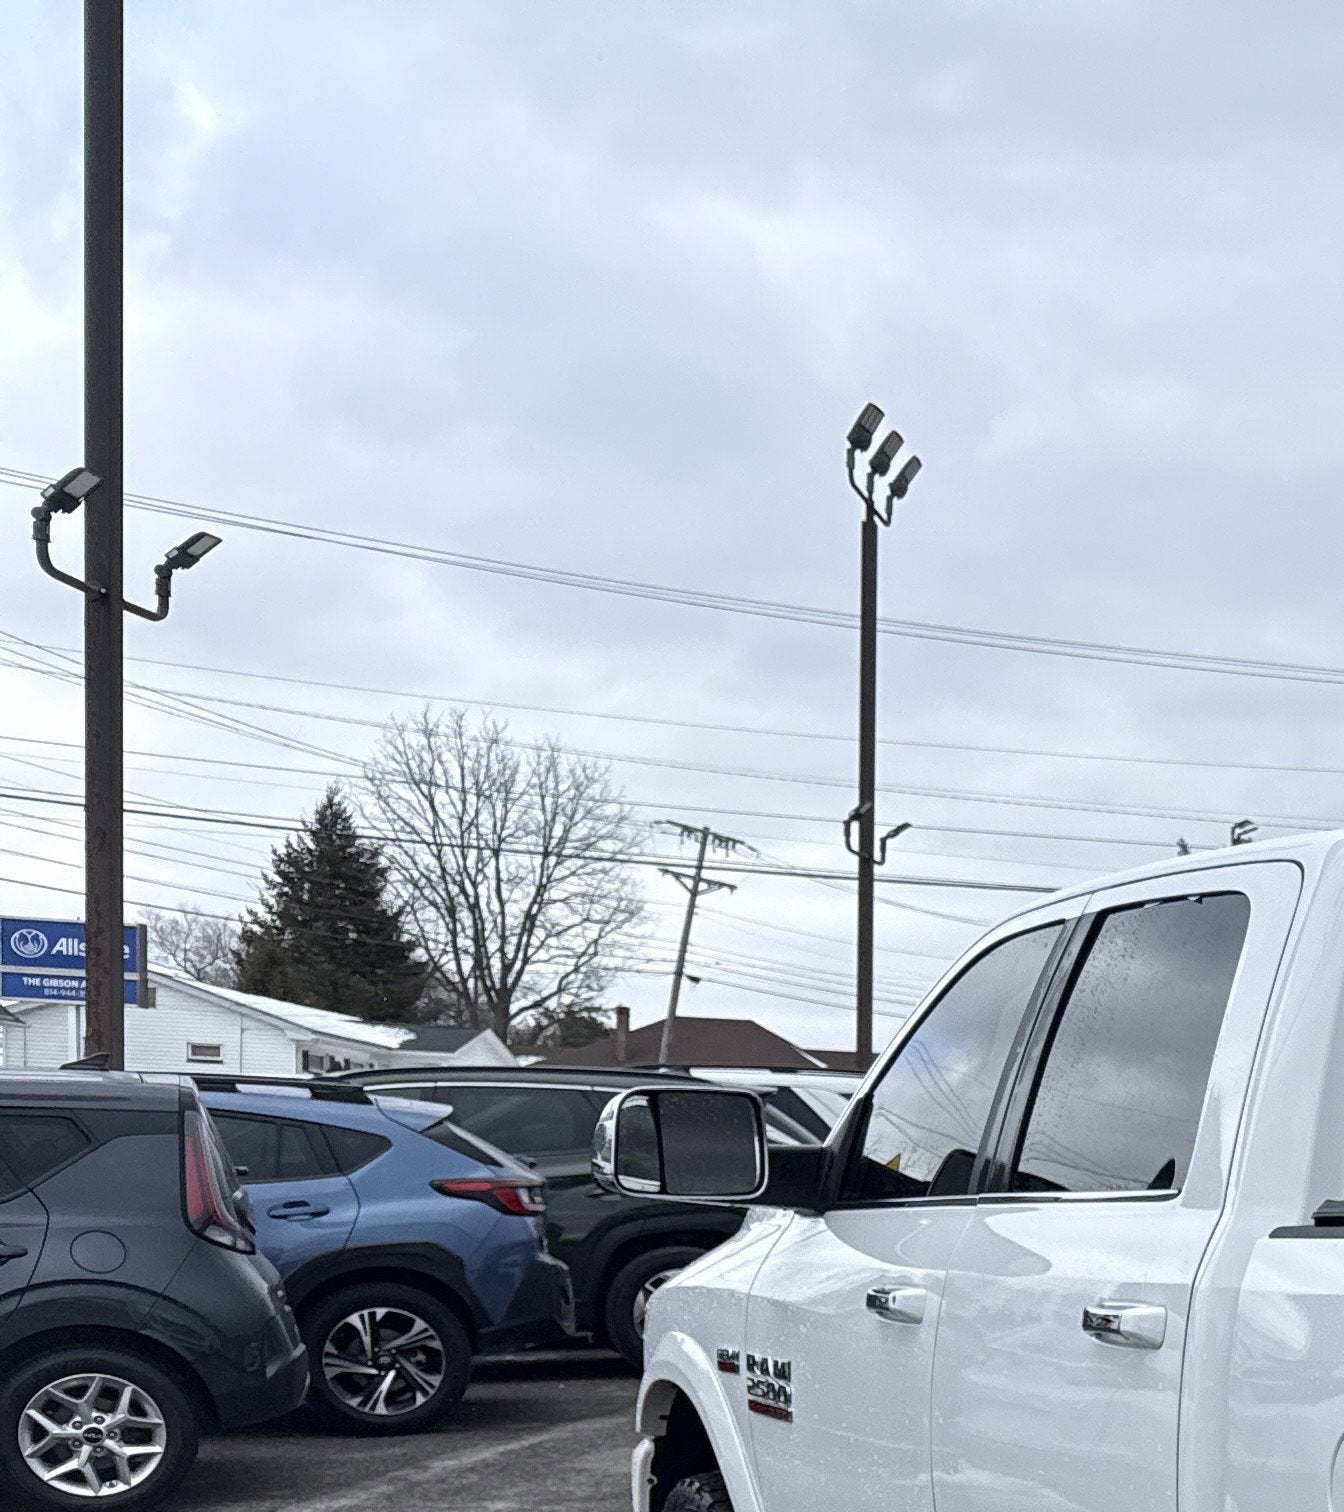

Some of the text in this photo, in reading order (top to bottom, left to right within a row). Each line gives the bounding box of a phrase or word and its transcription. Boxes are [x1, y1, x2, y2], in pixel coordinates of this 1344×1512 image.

[51, 937, 130, 959] Allse
[22, 977, 41, 986] THE
[43, 978, 78, 989] GIBSON
[746, 1353, 792, 1383] RAM
[747, 1377, 792, 1406] 2500
